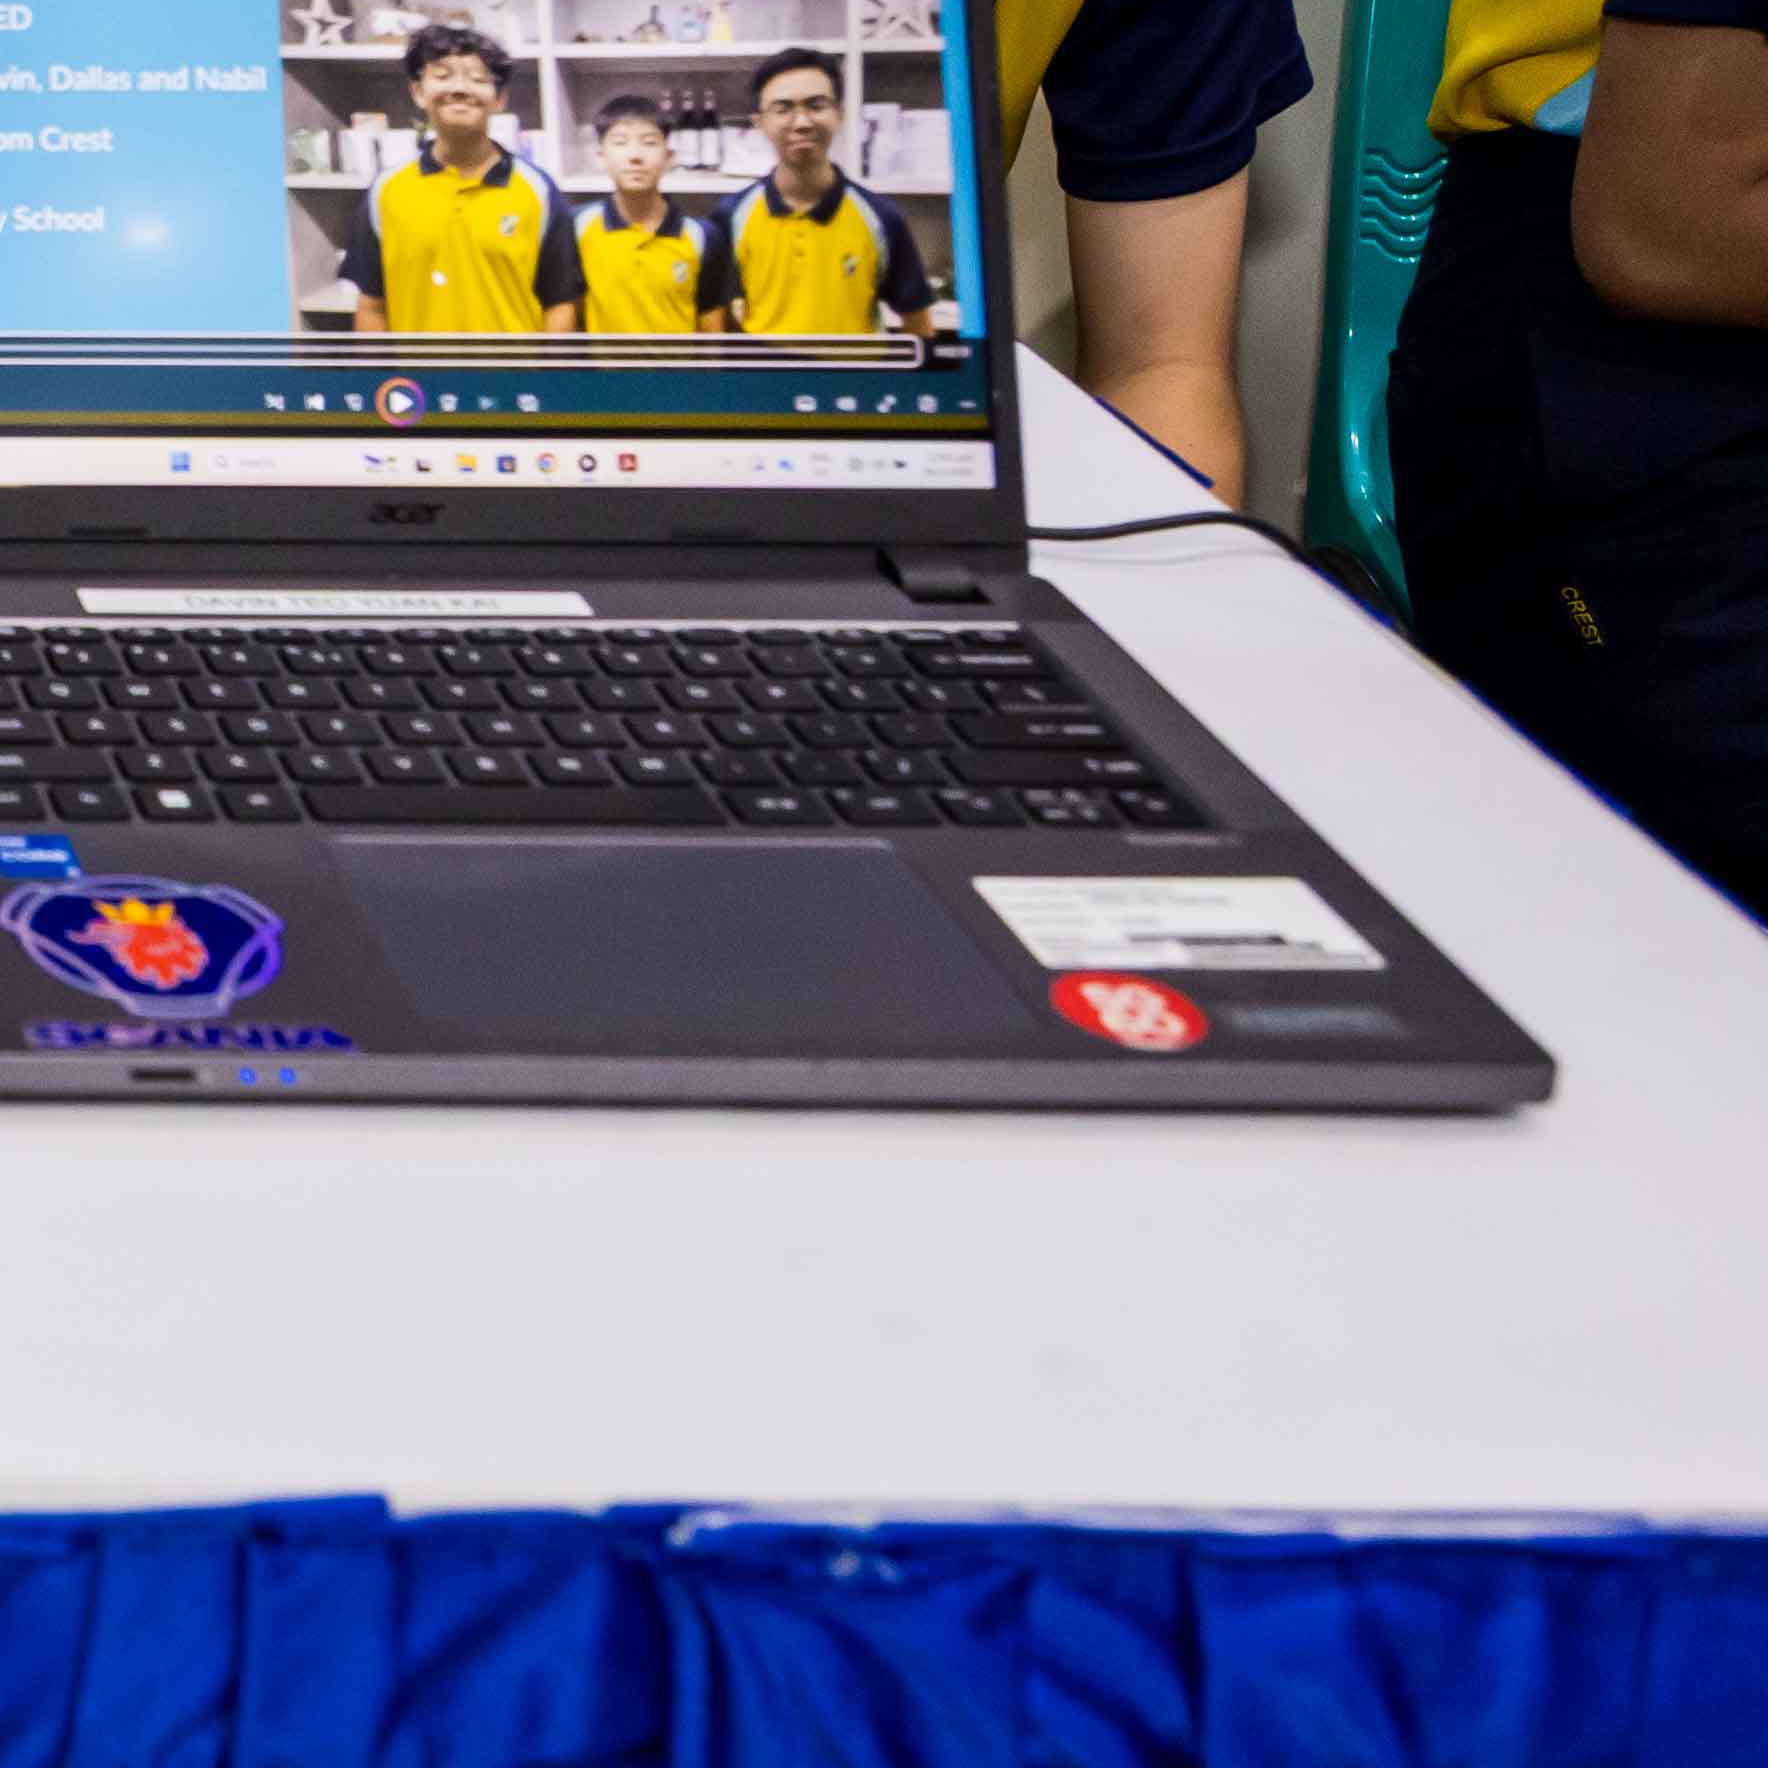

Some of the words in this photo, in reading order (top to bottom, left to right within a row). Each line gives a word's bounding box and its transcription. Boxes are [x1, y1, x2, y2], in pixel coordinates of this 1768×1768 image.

[48, 65, 132, 92] Dallas
[137, 66, 189, 91] and
[194, 66, 267, 91] Nabil
[38, 125, 113, 153] Crest
[13, 205, 105, 233] School
[368, 502, 446, 525] acer
[1560, 585, 1606, 648] CREST
